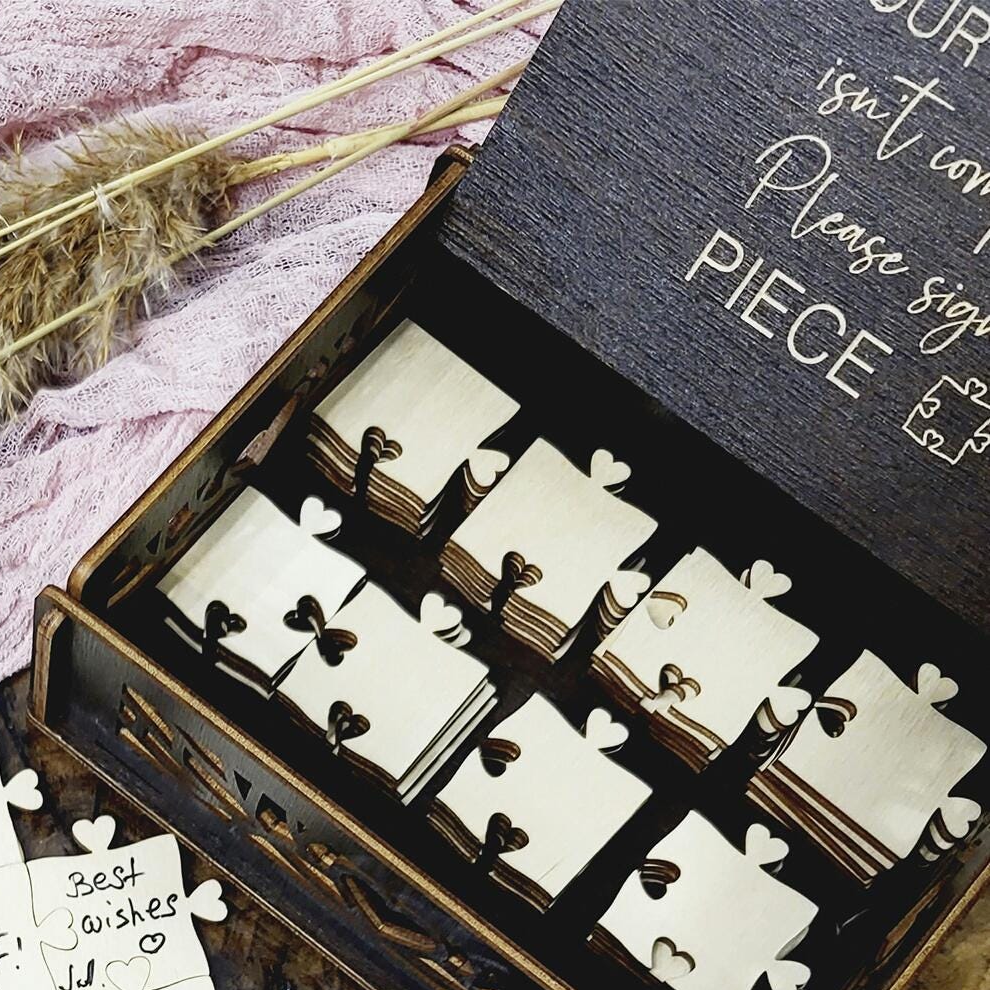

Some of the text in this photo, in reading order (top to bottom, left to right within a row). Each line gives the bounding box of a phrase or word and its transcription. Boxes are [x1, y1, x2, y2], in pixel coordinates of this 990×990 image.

[871, 0, 990, 67] UR
[816, 58, 955, 160] isn't
[745, 134, 909, 274] Please
[684, 228, 893, 399] PIECE
[66, 857, 145, 898] Best
[81, 893, 178, 934] wishes
